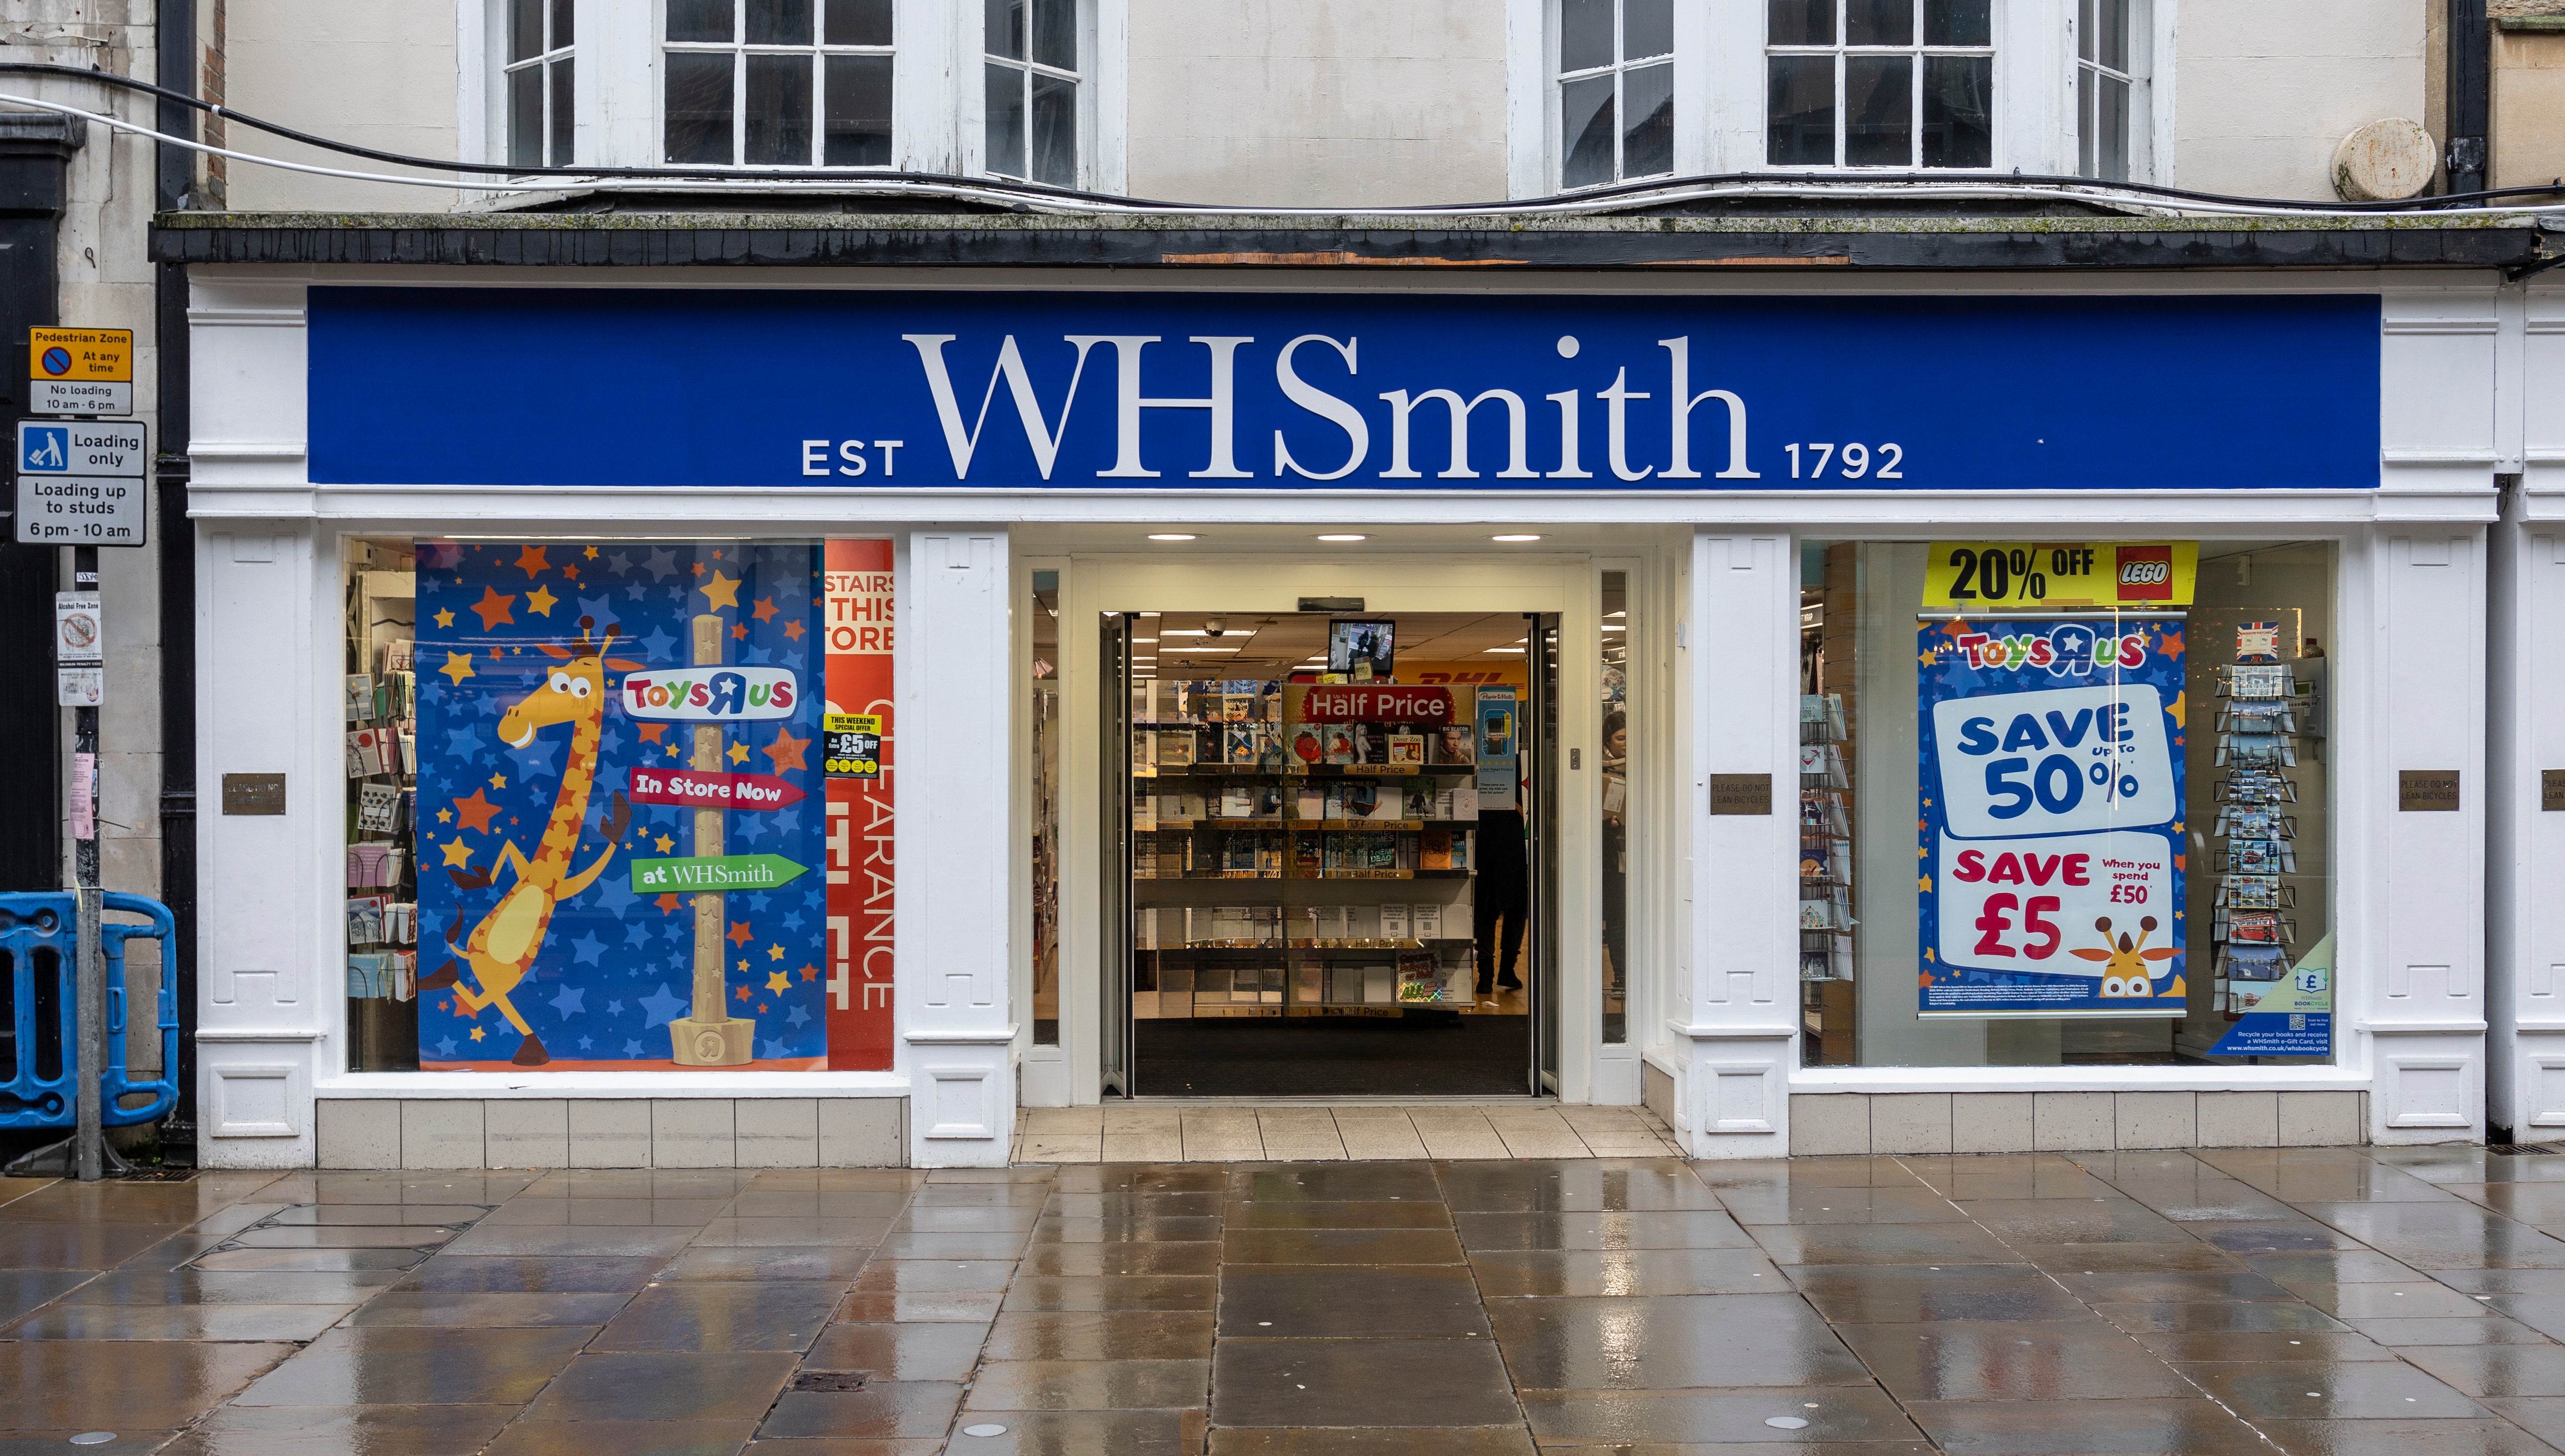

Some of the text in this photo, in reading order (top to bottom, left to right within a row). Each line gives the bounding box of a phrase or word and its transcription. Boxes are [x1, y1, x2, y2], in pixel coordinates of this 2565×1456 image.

[35, 332, 127, 344] Pedestrian Zone
[83, 352, 120, 363] At any
[89, 364, 114, 373] time
[51, 385, 112, 397] No loading
[47, 400, 61, 408] 10
[88, 400, 96, 409] 6
[98, 402, 115, 411] pm
[803, 334, 1904, 482] EST WHSmith 1792
[75, 434, 139, 450] Loading
[89, 452, 124, 467] only
[35, 483, 126, 500] Loading up
[46, 500, 115, 514] to studs
[30, 523, 131, 538] 6 pm 10 am
[1948, 549, 2095, 600] 20% OFF
[2120, 562, 2168, 584] LEGO
[825, 626, 893, 650] ORE
[1313, 693, 1445, 716] Half Price
[847, 717, 875, 725] WEEKEND
[1957, 702, 2134, 756] SAVE
[840, 734, 864, 753] £5
[864, 740, 878, 749] OFF
[2092, 744, 2136, 757] Up To
[1357, 765, 1405, 774] Half Price
[268, 783, 283, 792] NOT
[636, 774, 782, 801] In Store Now
[1713, 784, 1770, 792] PLEASE DO NOT
[1985, 753, 2139, 819] 50%
[2401, 780, 2428, 788] PLEASE
[1735, 795, 1769, 804] BICYCLES
[1383, 821, 1409, 830] Price
[1953, 850, 2090, 886] SAVE
[2102, 859, 2160, 871] When you
[643, 864, 775, 885] at WHSmith
[1353, 870, 1371, 879] Half
[2112, 871, 2149, 881] spend
[2110, 884, 2148, 904] £50
[1974, 893, 2061, 960] £5
[1355, 940, 1404, 948] Half Price
[2306, 975, 2317, 989] £
[1364, 1008, 1389, 1016] Price
